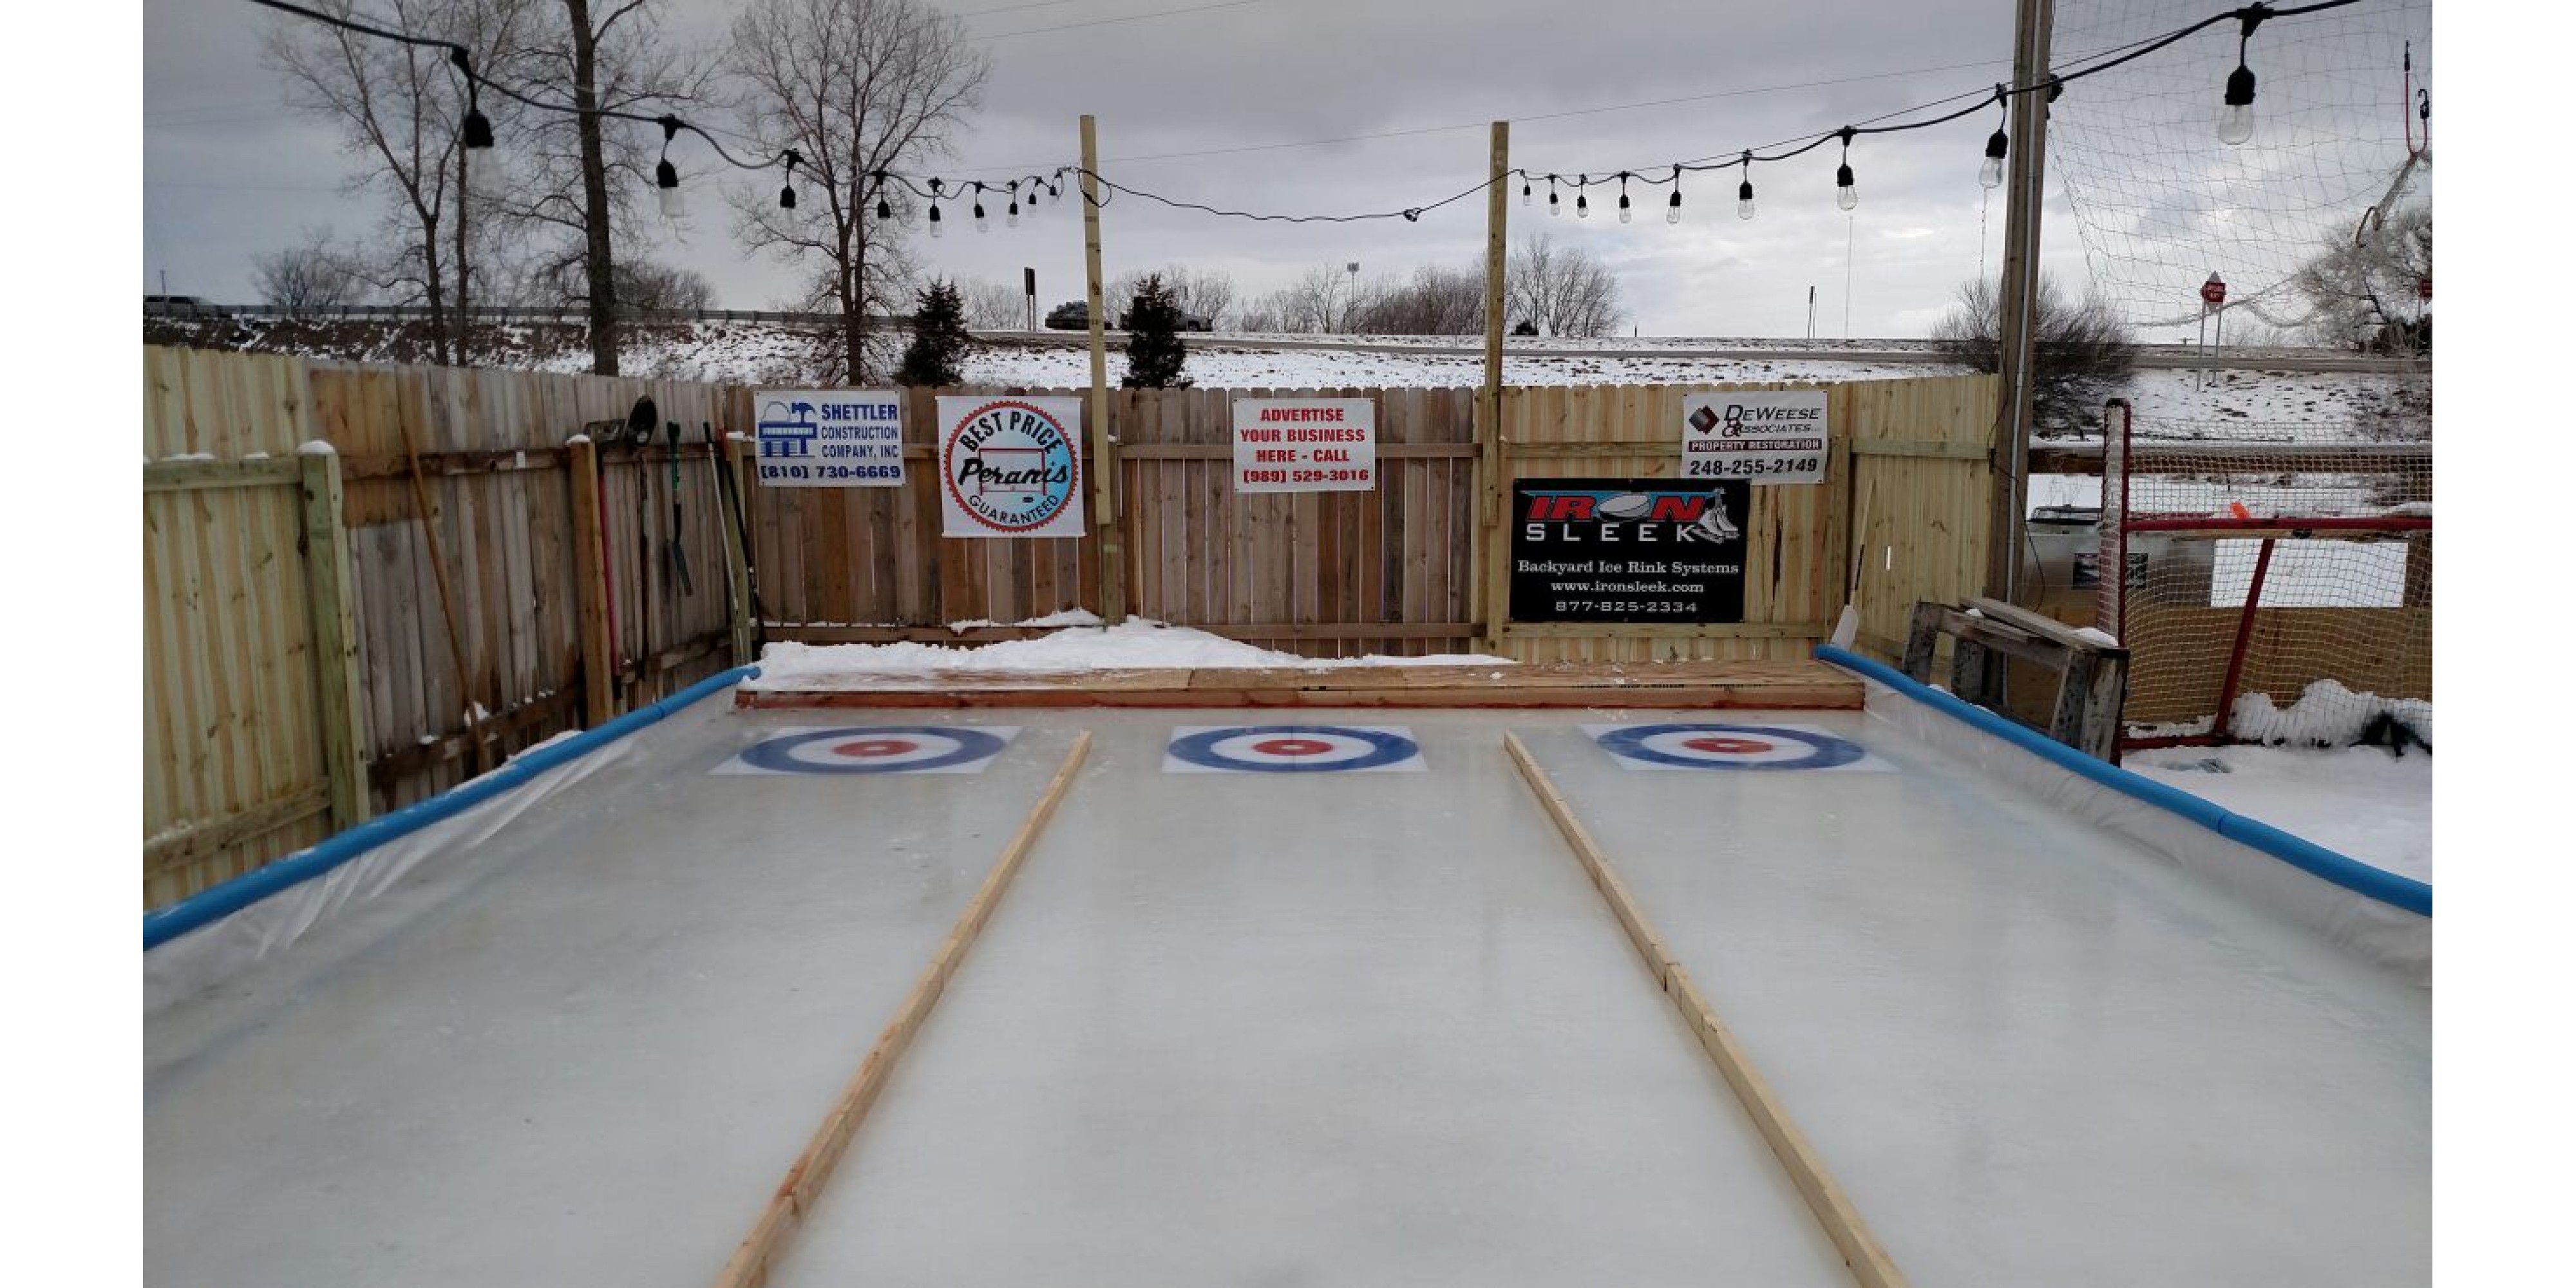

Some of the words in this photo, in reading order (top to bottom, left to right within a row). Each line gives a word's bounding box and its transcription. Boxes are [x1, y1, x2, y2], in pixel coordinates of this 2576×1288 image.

[821, 404, 898, 421] SHETTLER
[1260, 408, 1344, 421] ADVERTISE
[821, 425, 899, 440] CONSTRUCTION
[959, 411, 1003, 452] BEST
[1010, 411, 1063, 453] PRICE
[1240, 429, 1282, 442] YOUR
[1287, 429, 1365, 442] BUSINESS
[1692, 441, 1745, 451] PROPERTY
[1748, 439, 1819, 450] RESTORATION
[821, 444, 878, 461] COMPANY,
[880, 444, 899, 458] INC
[1256, 450, 1297, 463] HERE
[1312, 450, 1350, 463] CALL
[816, 466, 901, 478] 730-6669
[1690, 459, 1818, 475] 248-255-2149
[1292, 469, 1369, 482] 529-3016
[969, 495, 1059, 524] GUARANTEED
[1518, 560, 1593, 576] Backyard
[1598, 561, 1622, 573] Ice
[1627, 561, 1667, 573] Rink
[1671, 562, 1739, 576] Systems
[1551, 581, 1704, 592] www.ironsleek.com
[1555, 601, 1697, 612] 877-825-2334
